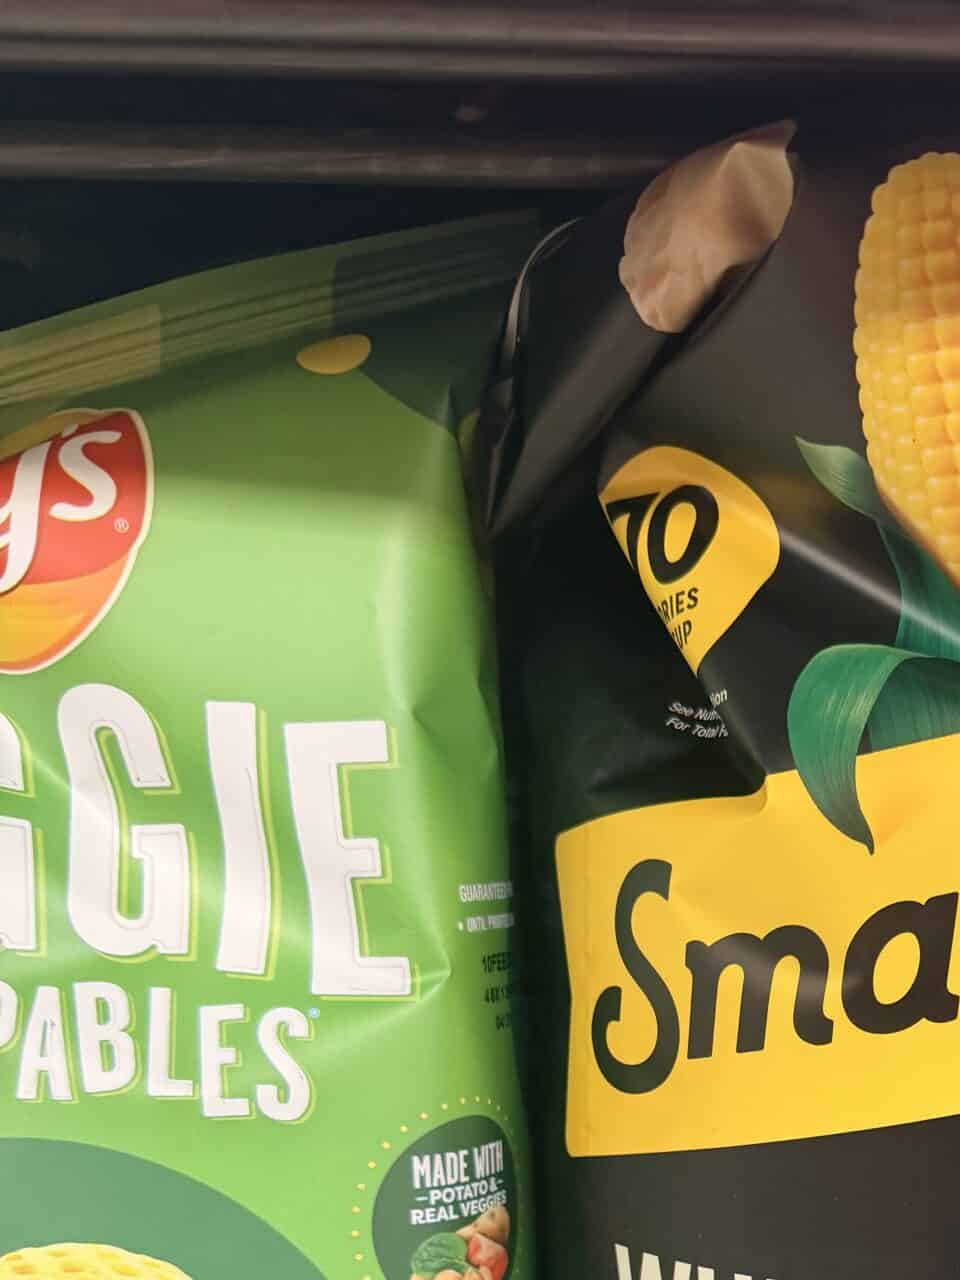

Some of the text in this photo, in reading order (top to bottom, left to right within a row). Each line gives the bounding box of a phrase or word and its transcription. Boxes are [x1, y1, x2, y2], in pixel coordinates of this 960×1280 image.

[411, 1140, 504, 1189] MADE WITH
[429, 1181, 489, 1205] POTATO
[410, 1207, 460, 1225] REAL
